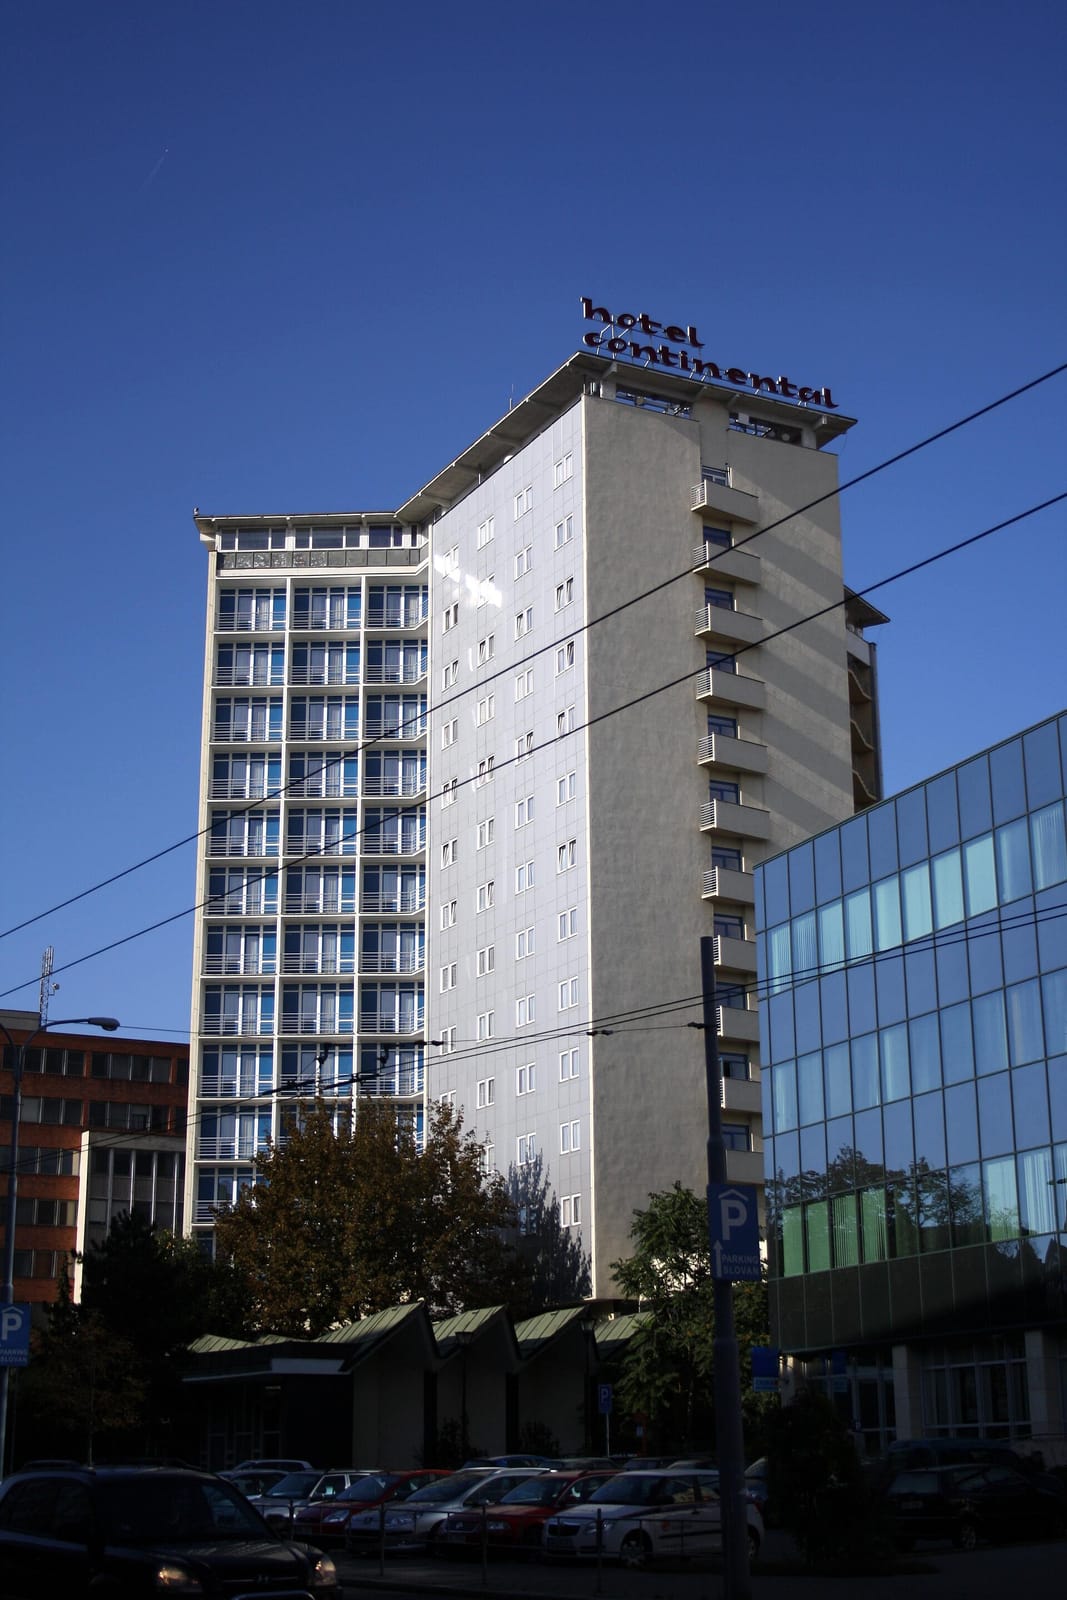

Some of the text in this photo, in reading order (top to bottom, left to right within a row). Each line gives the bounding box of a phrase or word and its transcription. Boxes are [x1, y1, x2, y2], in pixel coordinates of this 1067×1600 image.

[580, 296, 705, 348] hotel
[583, 332, 839, 409] continental
[720, 1200, 748, 1240] P
[721, 1253, 759, 1265] PARKING
[723, 1264, 760, 1275] SLOVAN
[1, 1312, 22, 1341] P
